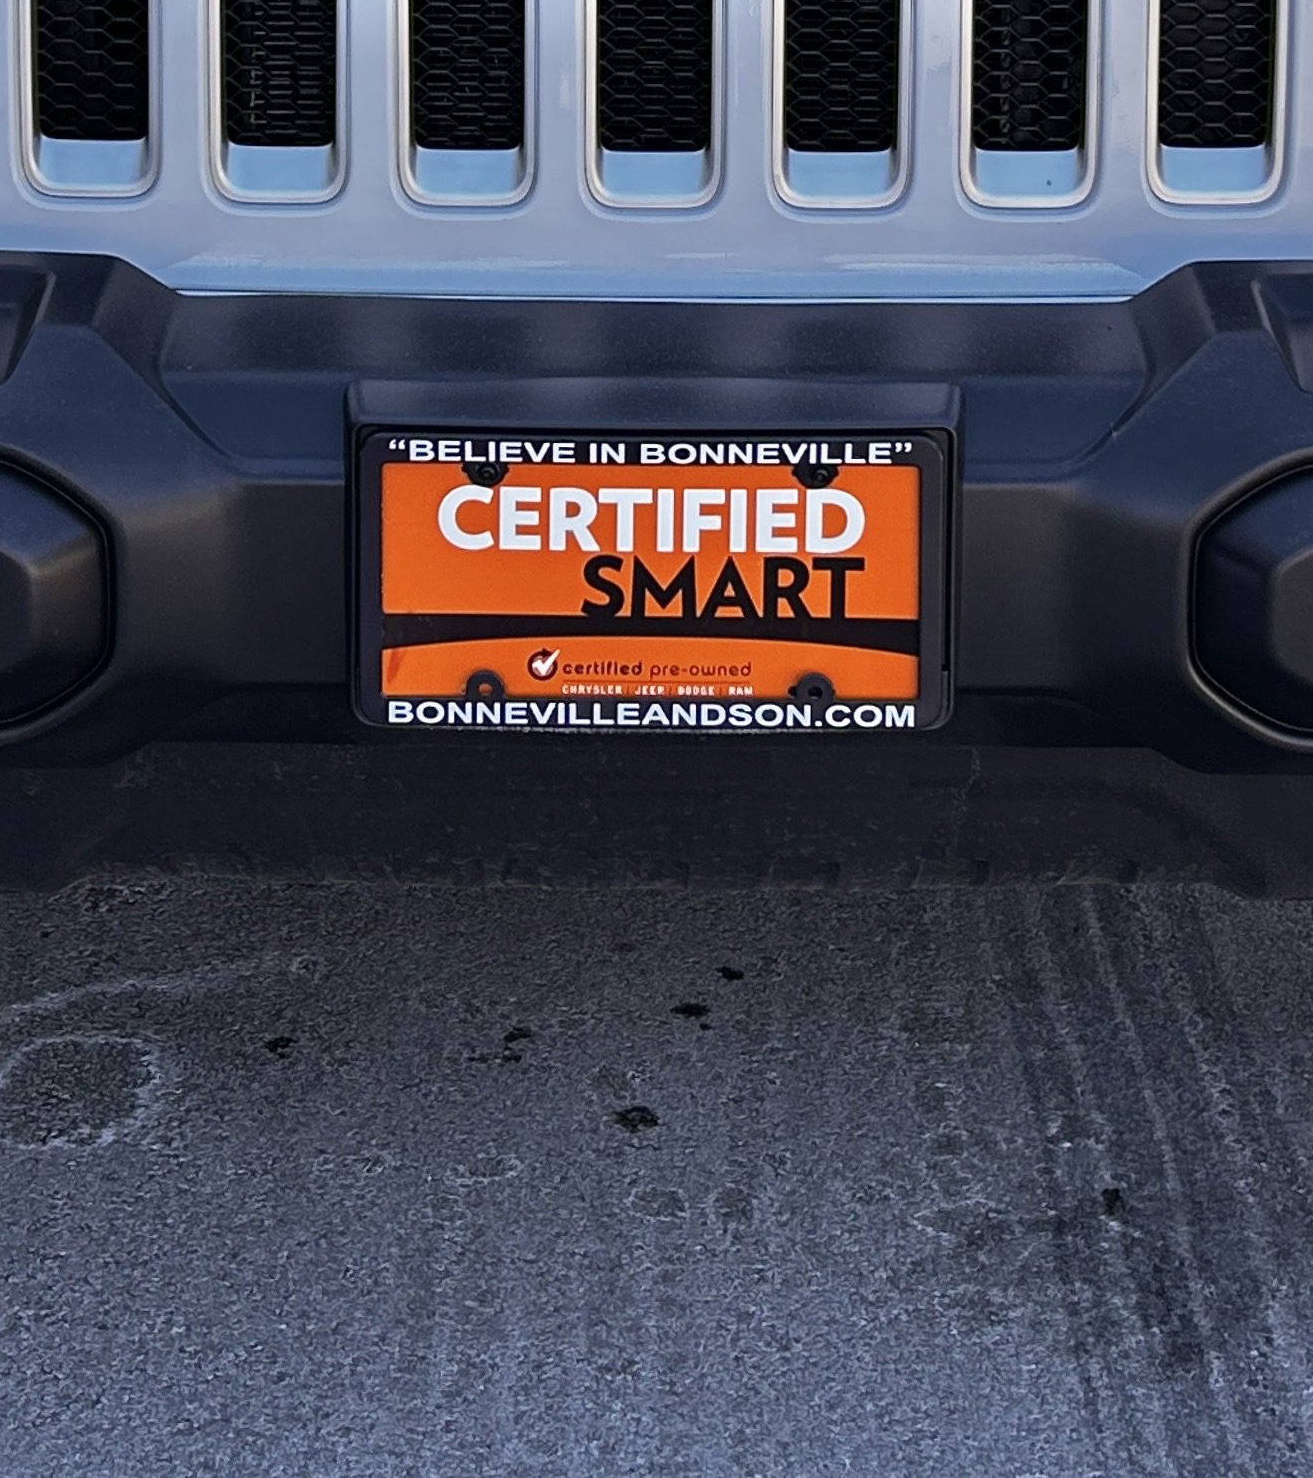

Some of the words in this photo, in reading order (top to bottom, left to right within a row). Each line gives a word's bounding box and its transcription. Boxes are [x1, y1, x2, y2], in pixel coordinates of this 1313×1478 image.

[388, 439, 576, 464] “BELIEVE
[589, 442, 626, 464] IN
[640, 442, 912, 465] BONNEVILLE”
[438, 485, 866, 554] CERTIFIED
[581, 554, 866, 620] SMART
[562, 661, 643, 676] certified
[650, 662, 752, 681] pre-owned
[562, 684, 623, 695] CHRYSLER
[635, 685, 665, 695] JEEP
[678, 685, 715, 696] DODGE
[728, 686, 753, 696] RAM
[387, 701, 916, 728] BONNEVILLEANDSON.COM
